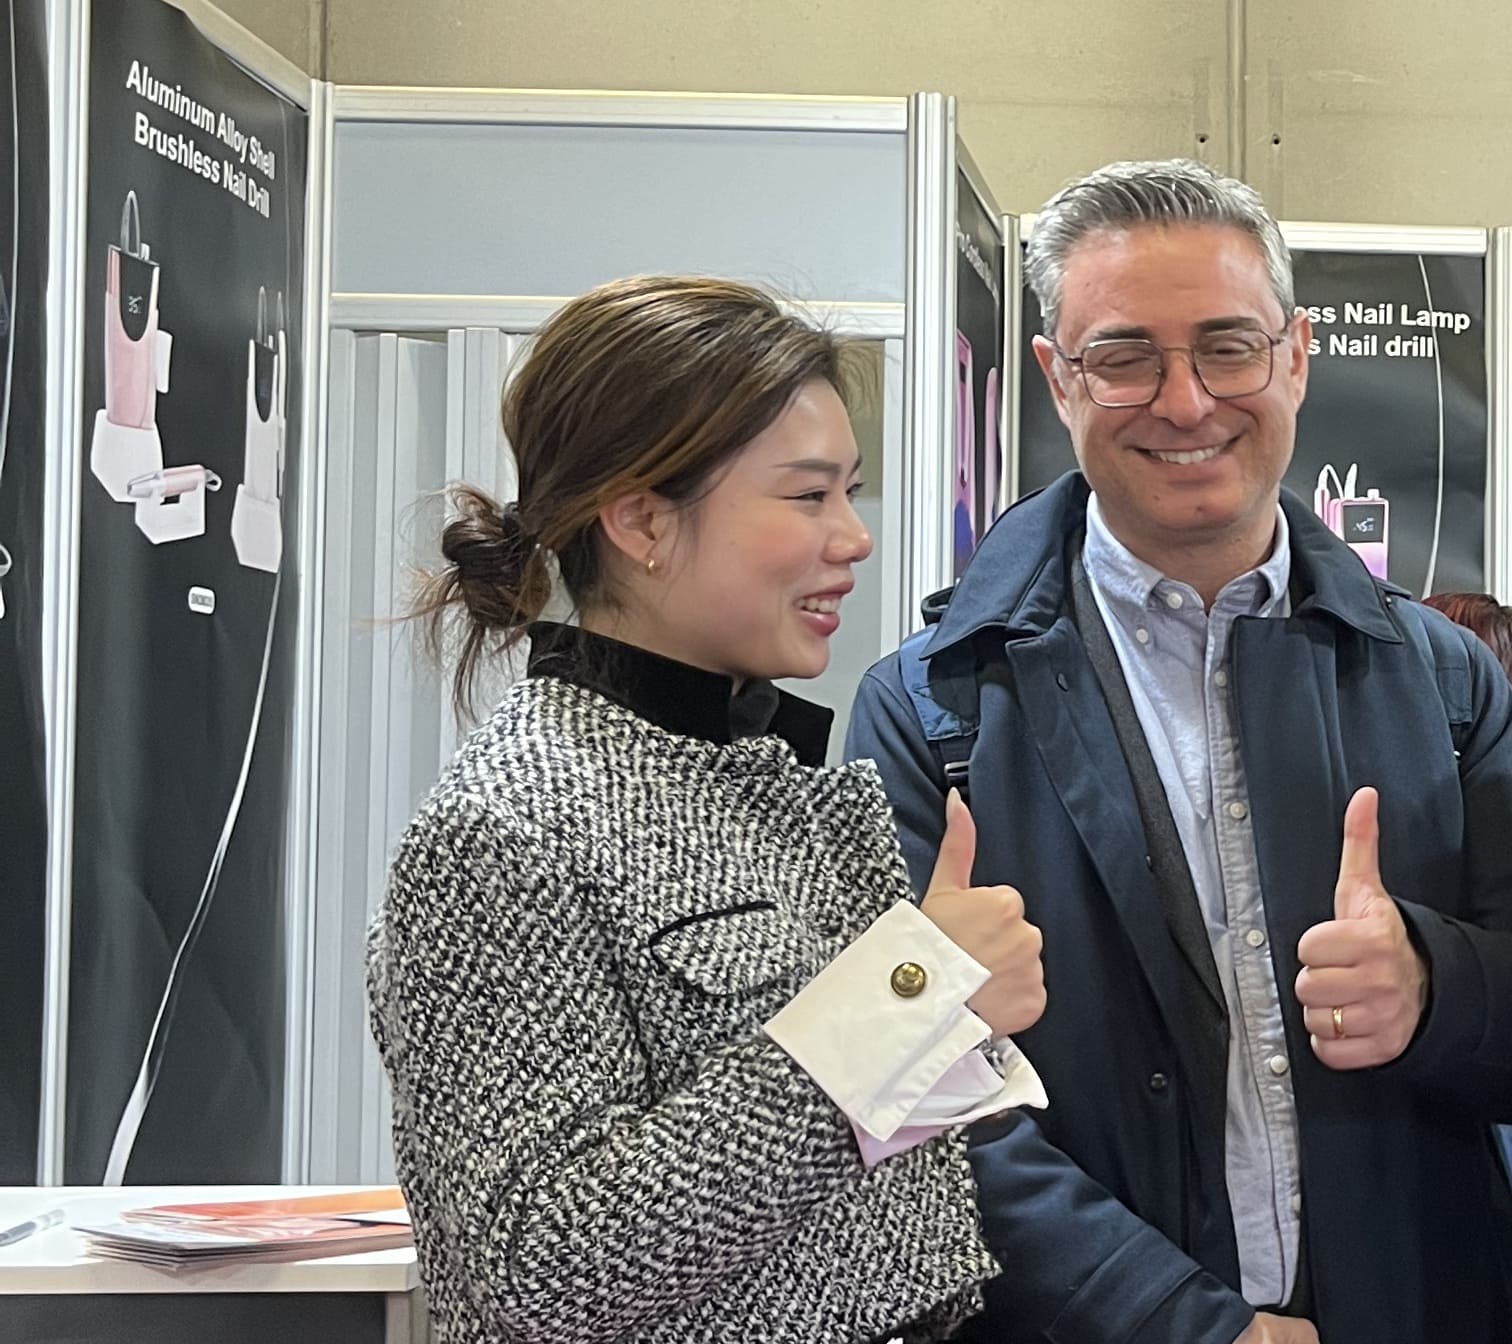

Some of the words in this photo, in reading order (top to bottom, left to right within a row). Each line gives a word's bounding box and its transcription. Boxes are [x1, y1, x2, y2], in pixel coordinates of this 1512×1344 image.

[126, 59, 215, 134] Aluminum
[217, 112, 248, 163] Alloy
[249, 136, 275, 180] Shell
[135, 111, 220, 183] Brushless
[223, 160, 247, 201] Nail
[248, 177, 270, 218] Drill
[1329, 334, 1378, 356] Nail
[1384, 335, 1434, 358] drill
[1343, 302, 1393, 325] Nail
[1401, 304, 1471, 334] Lamp
